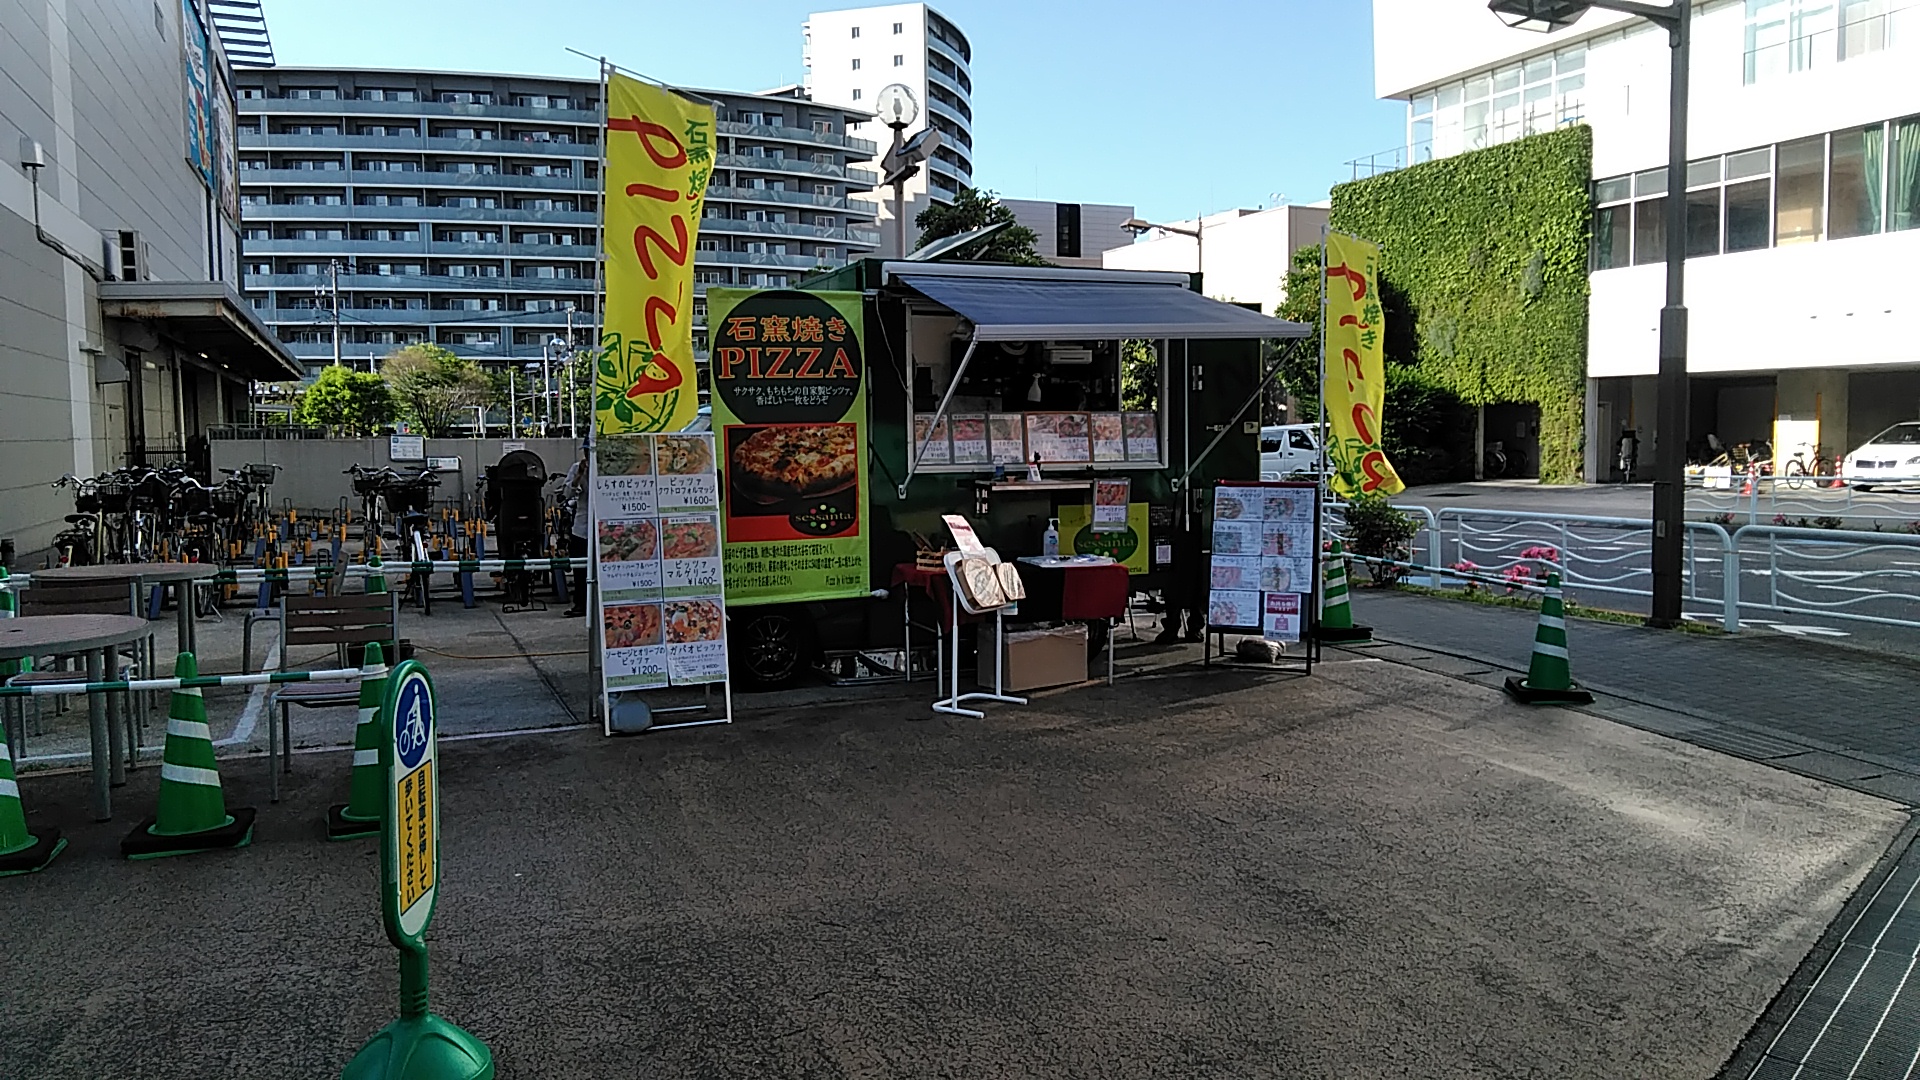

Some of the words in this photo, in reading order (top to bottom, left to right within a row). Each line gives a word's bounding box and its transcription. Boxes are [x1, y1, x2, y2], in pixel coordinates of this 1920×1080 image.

[726, 314, 847, 342] 石窯焼き
[717, 346, 859, 379] PIZZA
[596, 479, 656, 490] しらすのピッツァ
[683, 496, 713, 505] ¥1600-
[621, 502, 651, 512] ¥1500-
[667, 568, 717, 579] マルゲリータ
[687, 576, 718, 586] ¥1400-
[605, 646, 666, 659] ソーセージとオリーブの
[670, 643, 723, 656] ガパオピッツァ
[631, 664, 663, 675] ¥1200-
[405, 777, 415, 905] 歩いてください
